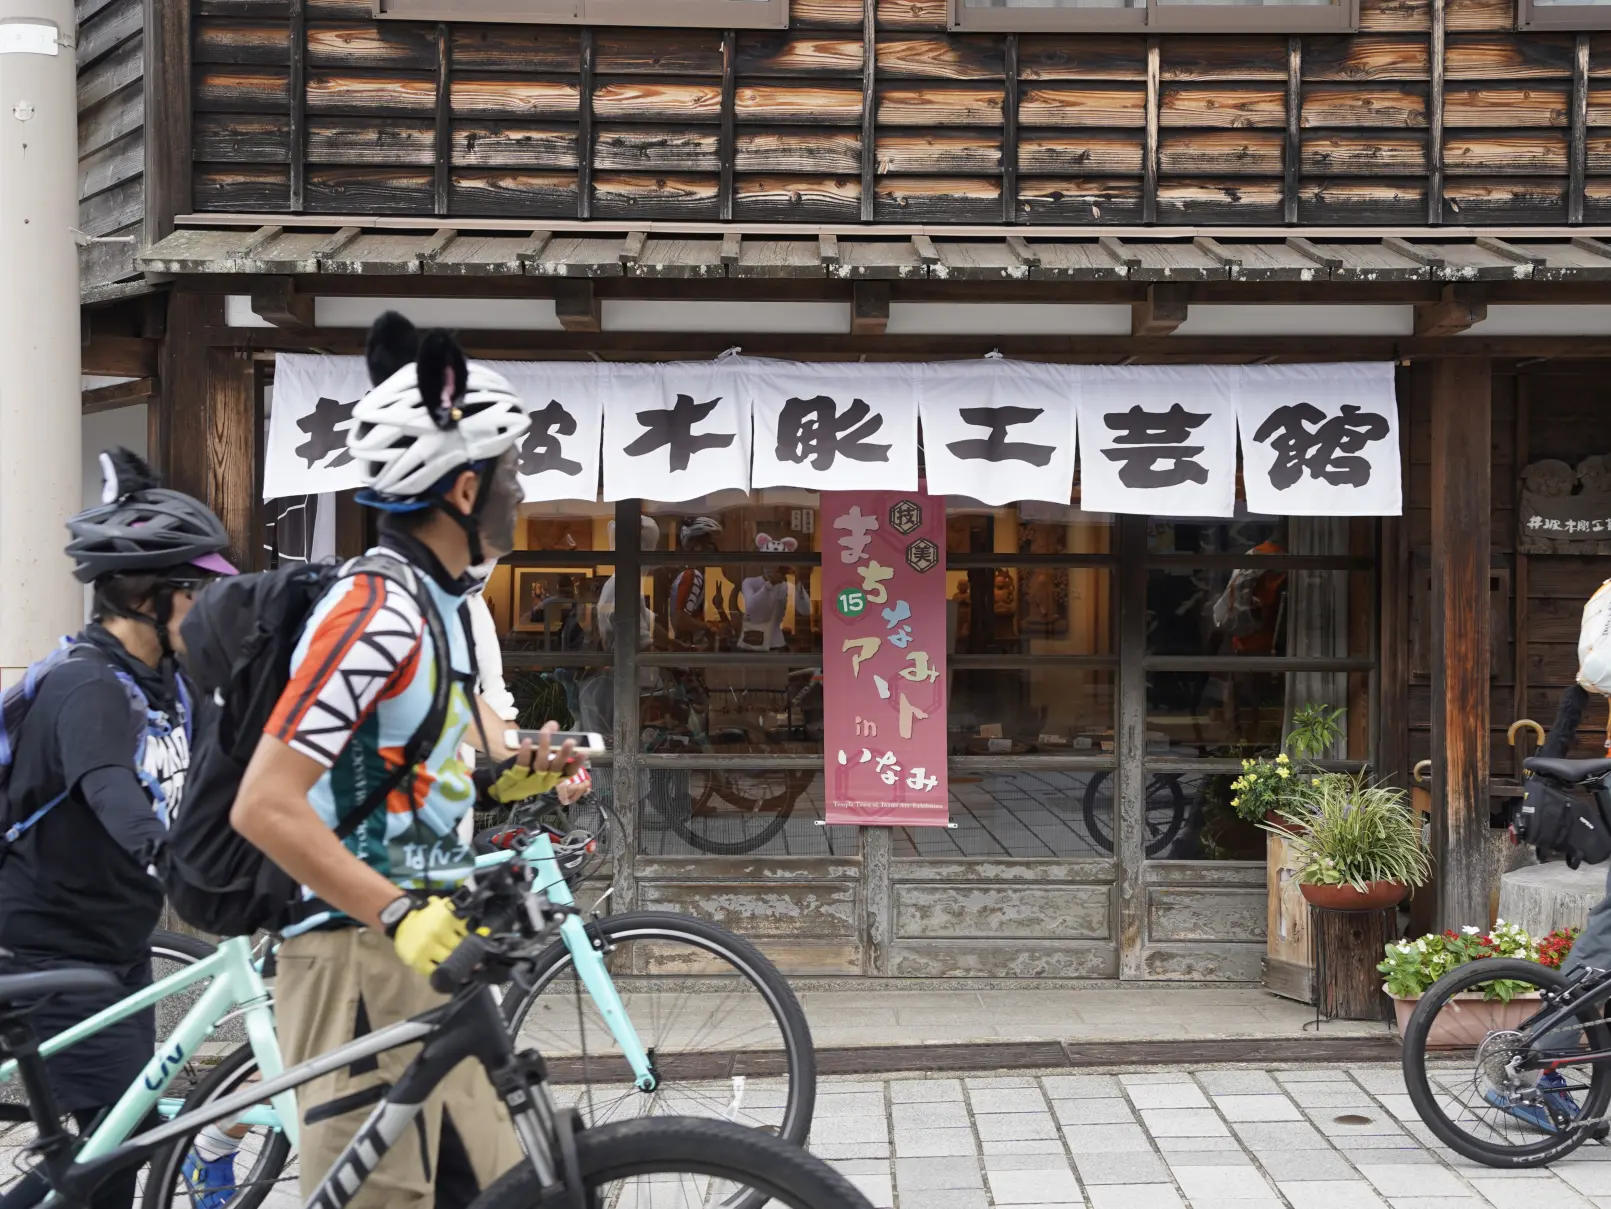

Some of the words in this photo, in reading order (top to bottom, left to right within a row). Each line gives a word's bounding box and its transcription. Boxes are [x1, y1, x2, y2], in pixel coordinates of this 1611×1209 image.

[839, 593, 864, 612] 15
[855, 716, 878, 737] in
[838, 748, 939, 792] いなみ
